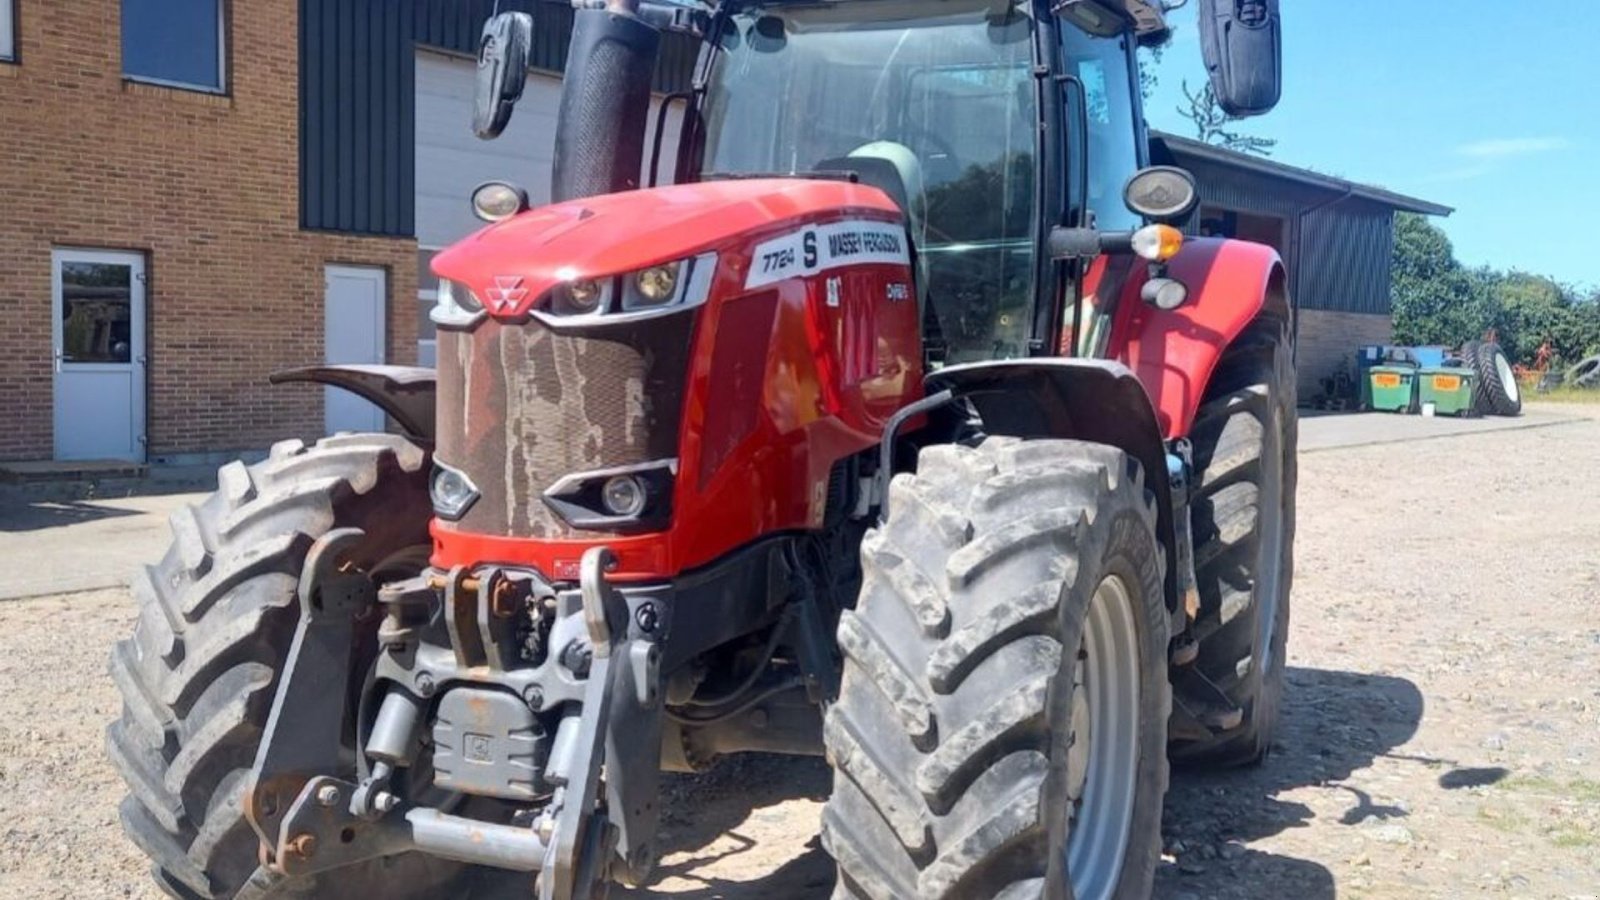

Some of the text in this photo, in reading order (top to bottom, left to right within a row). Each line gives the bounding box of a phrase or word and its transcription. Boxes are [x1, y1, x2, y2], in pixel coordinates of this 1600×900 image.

[763, 230, 901, 273] 7724 S MASSEY FERGUSON
